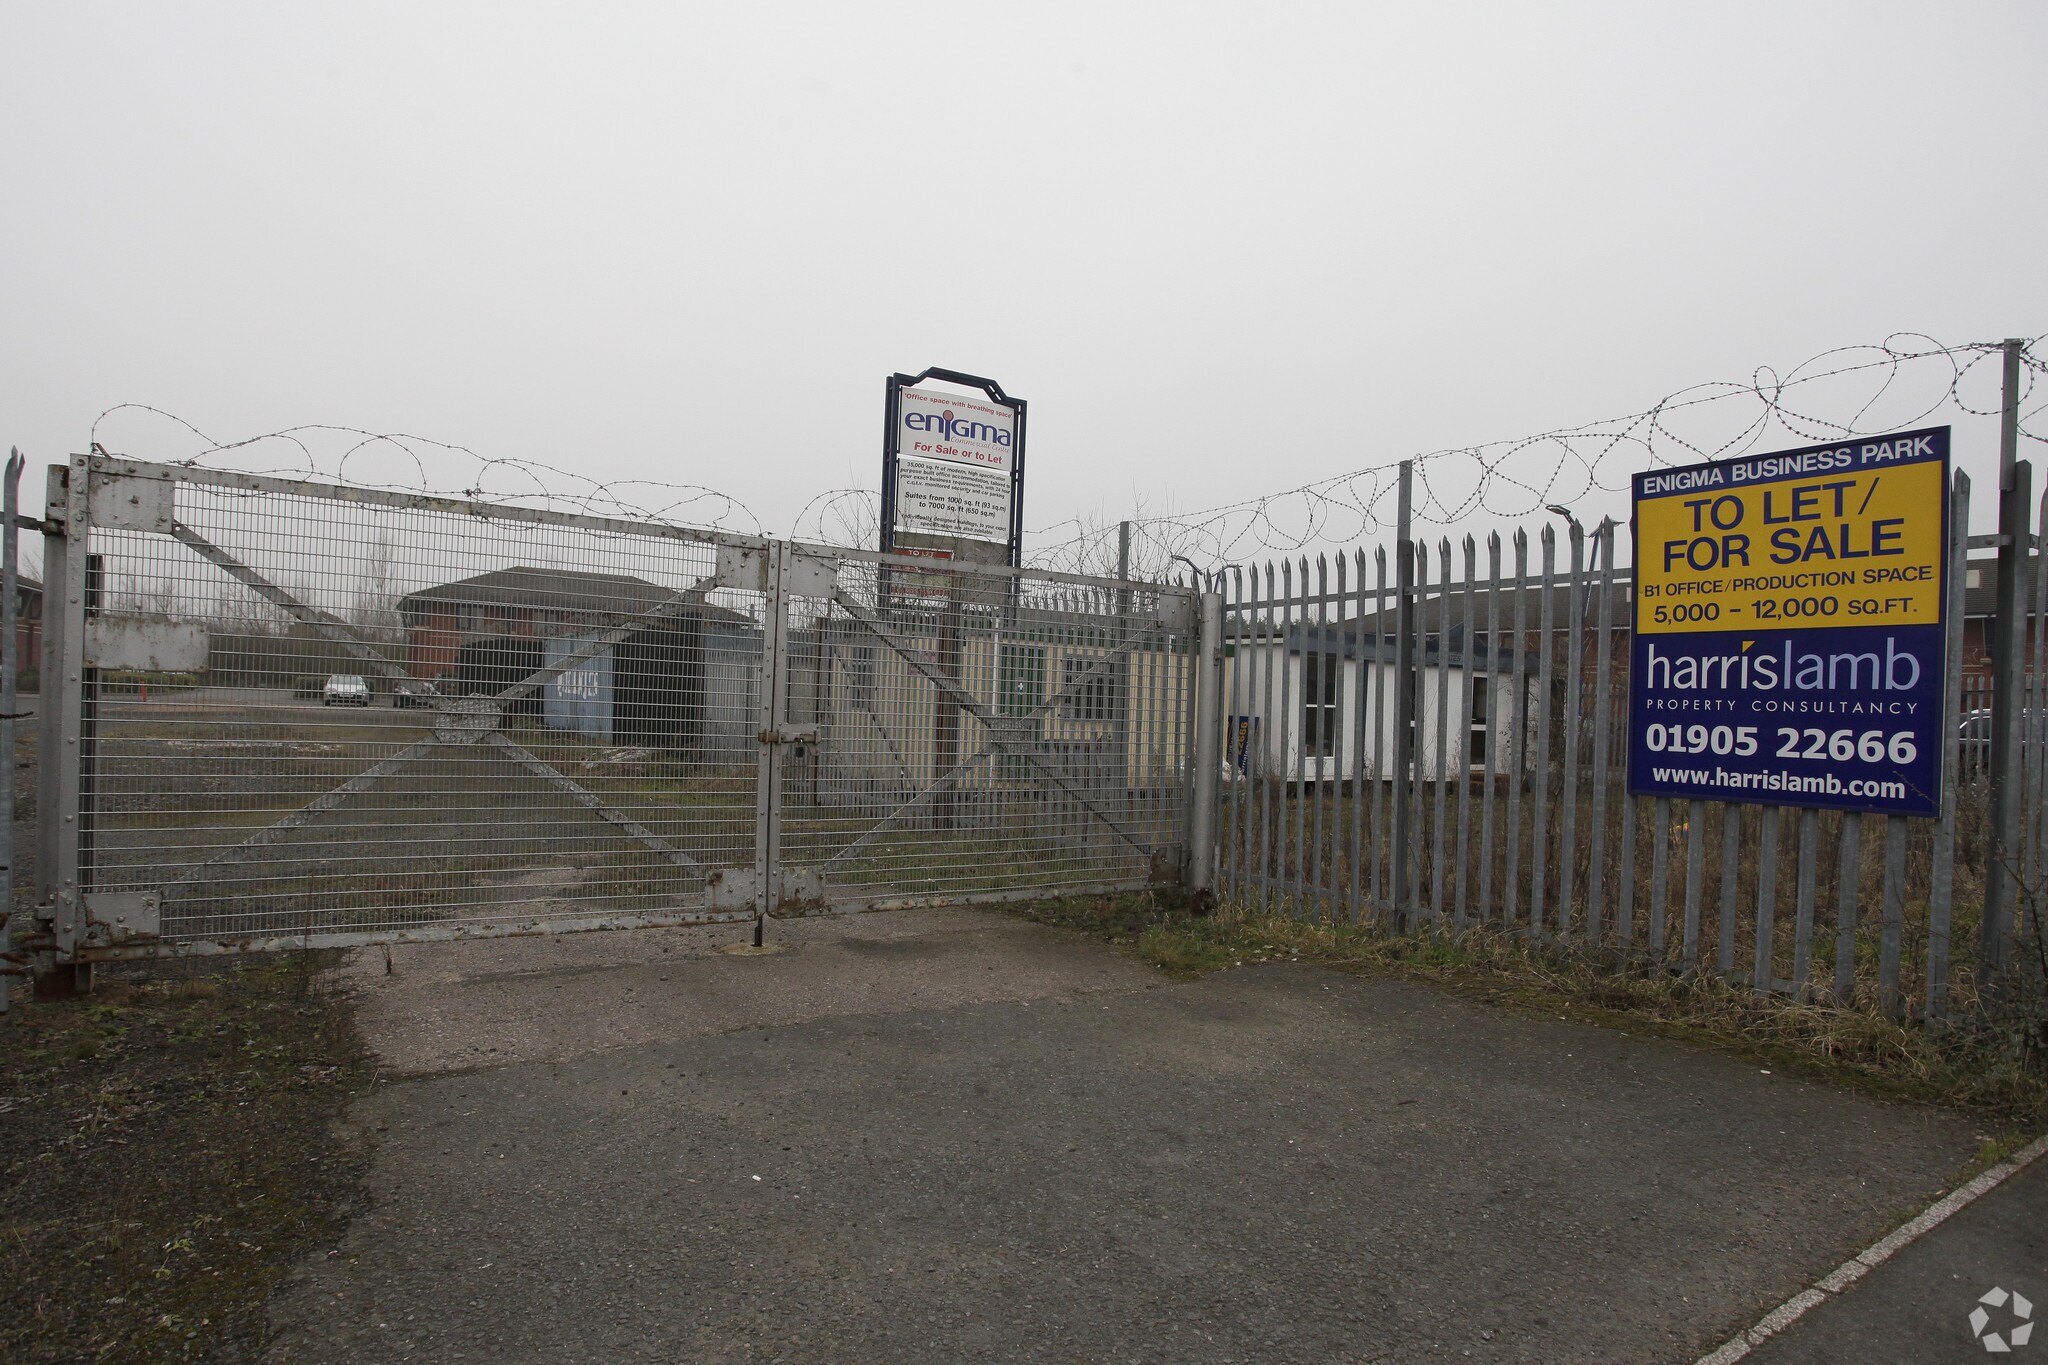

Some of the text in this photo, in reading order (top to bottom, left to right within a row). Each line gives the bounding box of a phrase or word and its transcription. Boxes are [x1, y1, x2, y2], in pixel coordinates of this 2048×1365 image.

[930, 397, 950, 405] space
[951, 400, 966, 408] with
[967, 403, 994, 415] breathing
[914, 441, 1002, 464] For Sale or to Let
[1643, 435, 1934, 495] ENIGMA BUSINESS PARK
[951, 486, 971, 494] security
[979, 473, 1006, 481] specification
[905, 491, 927, 500] Suites
[929, 493, 945, 502] from
[992, 504, 1006, 513] sq.m)
[928, 502, 946, 510] 7000
[980, 510, 996, 519] sq.m)
[1683, 494, 1745, 532] TO
[1663, 518, 1905, 573] FOR SALE
[1644, 584, 1661, 597] B1
[1862, 565, 1933, 584] SPACE
[1654, 602, 1721, 625] 5,000
[1751, 596, 1839, 622] 12,000
[1647, 637, 1921, 691] harrislamb
[1647, 699, 1918, 715] PROPERTY CONSULTANCY
[1646, 723, 1917, 764] 01905 22666
[1652, 766, 1905, 799] www.harrislamb.com
